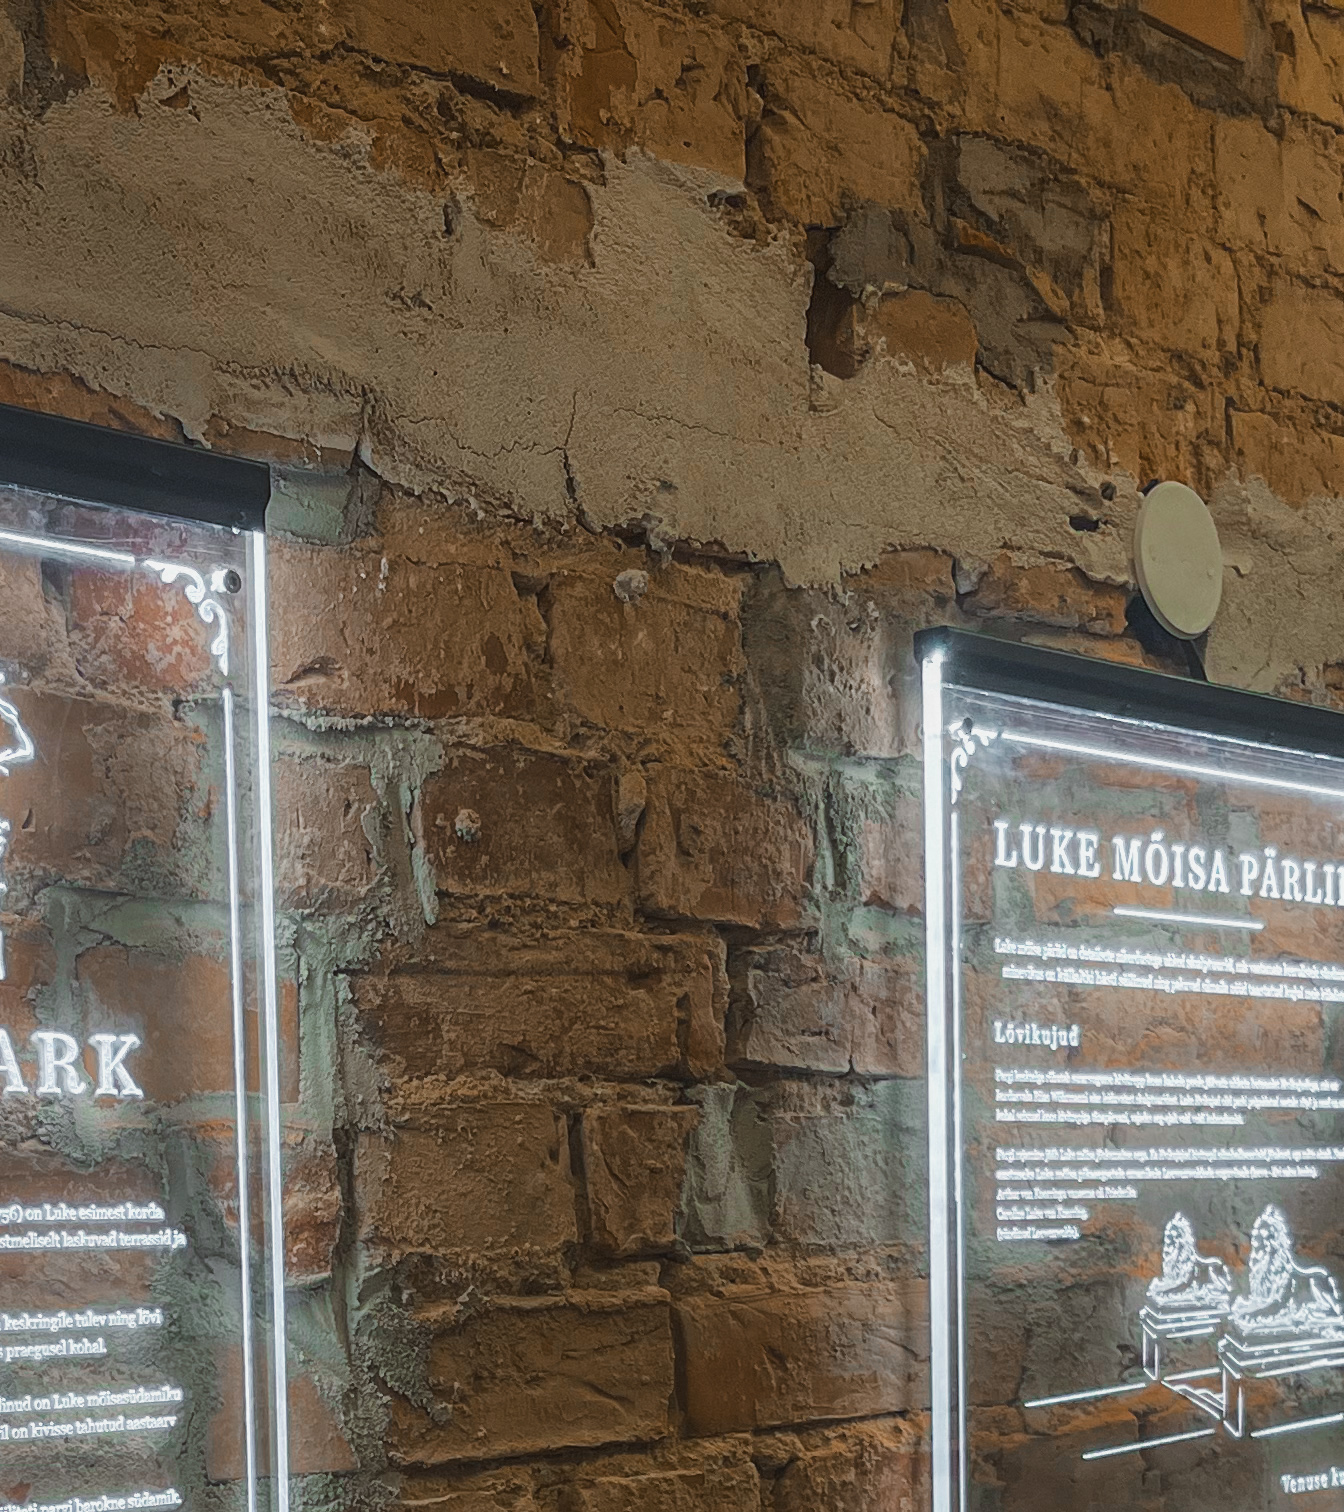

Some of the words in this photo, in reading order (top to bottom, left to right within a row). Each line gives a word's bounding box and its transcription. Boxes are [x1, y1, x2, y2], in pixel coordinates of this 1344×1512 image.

[993, 820, 1101, 878] LUKE
[24, 1209, 42, 1220] on
[44, 1203, 77, 1220] Luke
[126, 1202, 164, 1219] korda
[5, 1339, 67, 1361] praegusel
